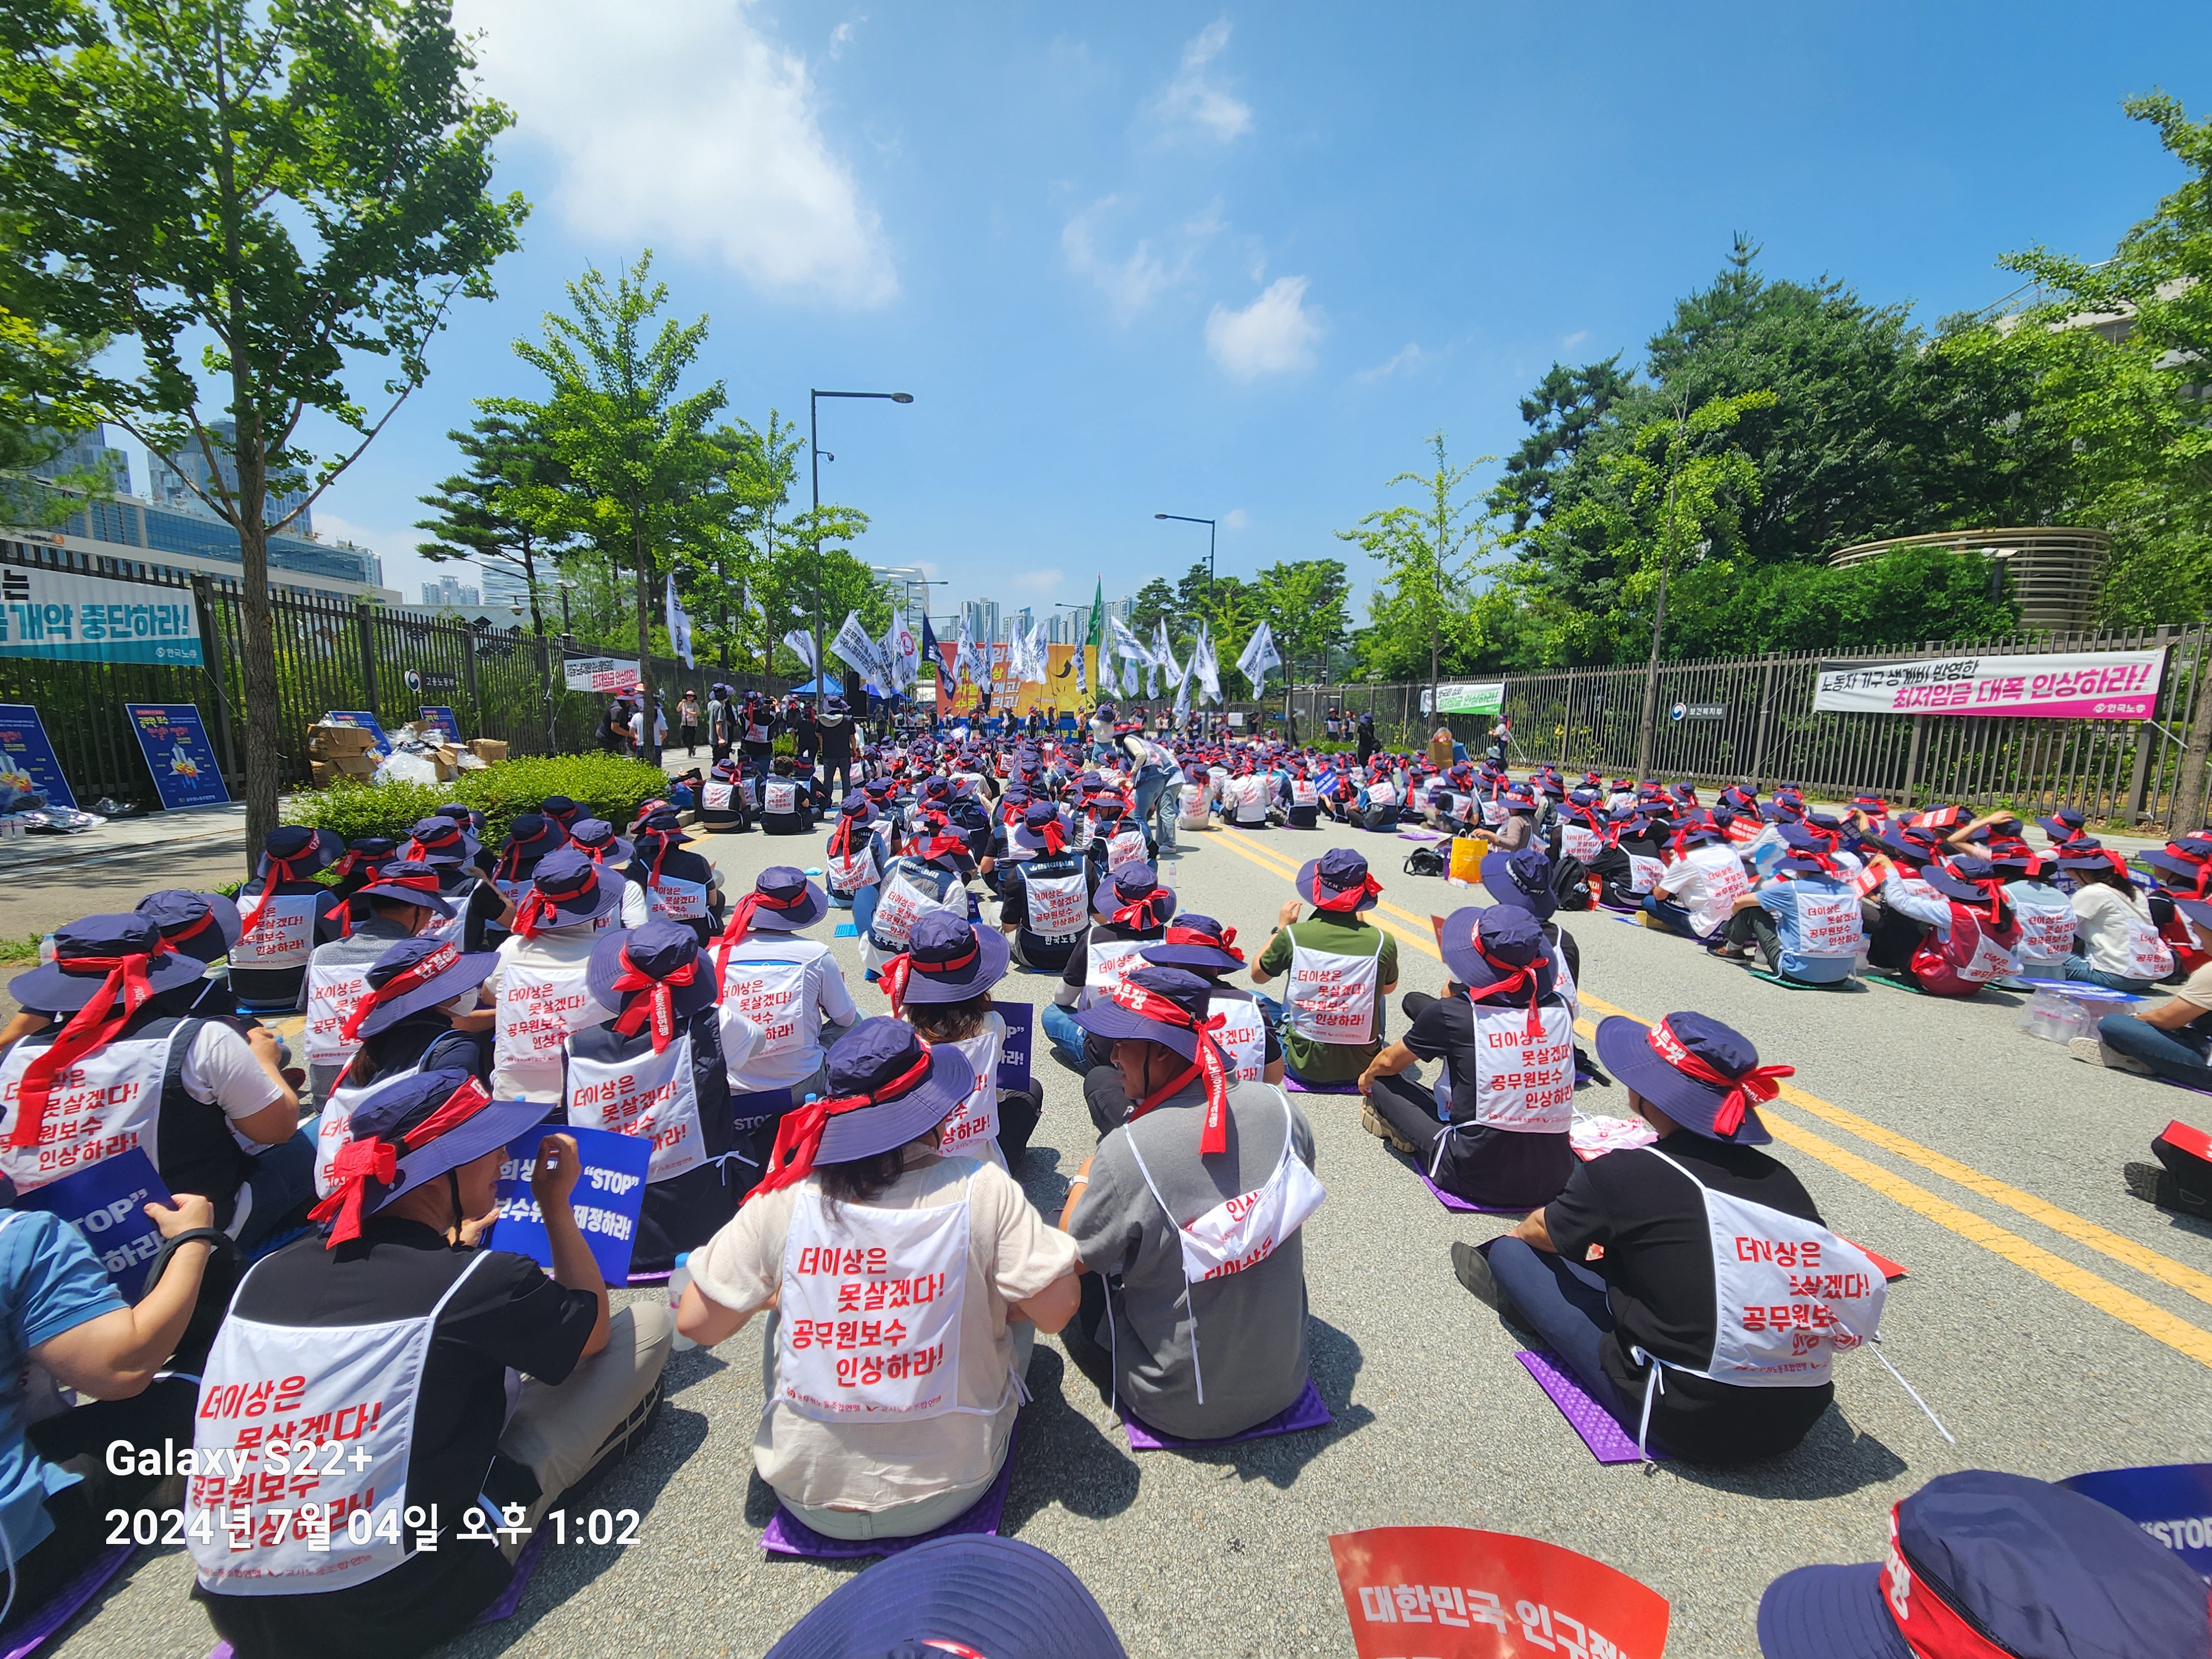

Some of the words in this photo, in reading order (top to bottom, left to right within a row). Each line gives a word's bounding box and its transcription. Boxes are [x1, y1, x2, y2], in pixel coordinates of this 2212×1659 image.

[0, 604, 73, 640] 개악
[81, 603, 189, 640] 중단하라!
[166, 648, 197, 659] 한국노총
[426, 676, 455, 687] 고용노동부
[1820, 672, 1858, 692] 노동자
[1886, 665, 1932, 687] 생계비
[1933, 659, 1980, 682] 반영한
[1892, 681, 1973, 709] 최저임금
[1975, 676, 2026, 705] 대폭
[2030, 663, 2153, 700] 인상하라!
[1689, 707, 1723, 716] 보건복지부
[2107, 703, 2146, 714] 한국노총
[1707, 866, 1734, 880] 더이상은
[664, 895, 700, 905] 못살겠다!
[887, 890, 916, 909] 더이상은
[1034, 888, 1064, 901] 더이상은
[1049, 894, 1082, 910] 못살겠다!
[1035, 909, 1073, 922] 공무원보수
[1051, 911, 1083, 928] 인상하라!
[1807, 903, 1841, 917] 더이상은
[256, 916, 303, 932] 못살겠다!
[2028, 915, 2063, 925] 더이상은
[1044, 934, 1077, 946] 한국노총
[1809, 924, 1851, 938] 공무원보수
[2027, 935, 2069, 945] 공무원보수
[255, 939, 304, 956] 인상하라!
[1297, 969, 1342, 983] 더이상은
[315, 979, 362, 1000] 더이상은
[508, 983, 554, 1003] 더이상은
[1318, 983, 1366, 999] 못살겠다!
[528, 994, 586, 1016] 못살겠다!
[739, 991, 792, 1013] 못살겠다!
[507, 1018, 567, 1038] 공무원보수
[1315, 1013, 1365, 1027] 인상하라!
[765, 1023, 795, 1040] 하라!
[1491, 1070, 1563, 1092] 공무원보수
[573, 1074, 636, 1108] 더이상은
[602, 1080, 677, 1124] 못살겠다!
[941, 1114, 990, 1145] 상하라!
[39, 1131, 138, 1172] 인상하라!
[583, 1165, 640, 1196] “STOP”
[573, 1204, 632, 1241] 제정하라!
[797, 1246, 887, 1277] 더이상은
[837, 1272, 945, 1313] 못살겠다!
[792, 1318, 907, 1350] 공무원보수
[836, 1342, 943, 1388] 인상하라!
[199, 1375, 306, 1421] 더이상은
[1358, 1583, 1508, 1634] 대한민국
